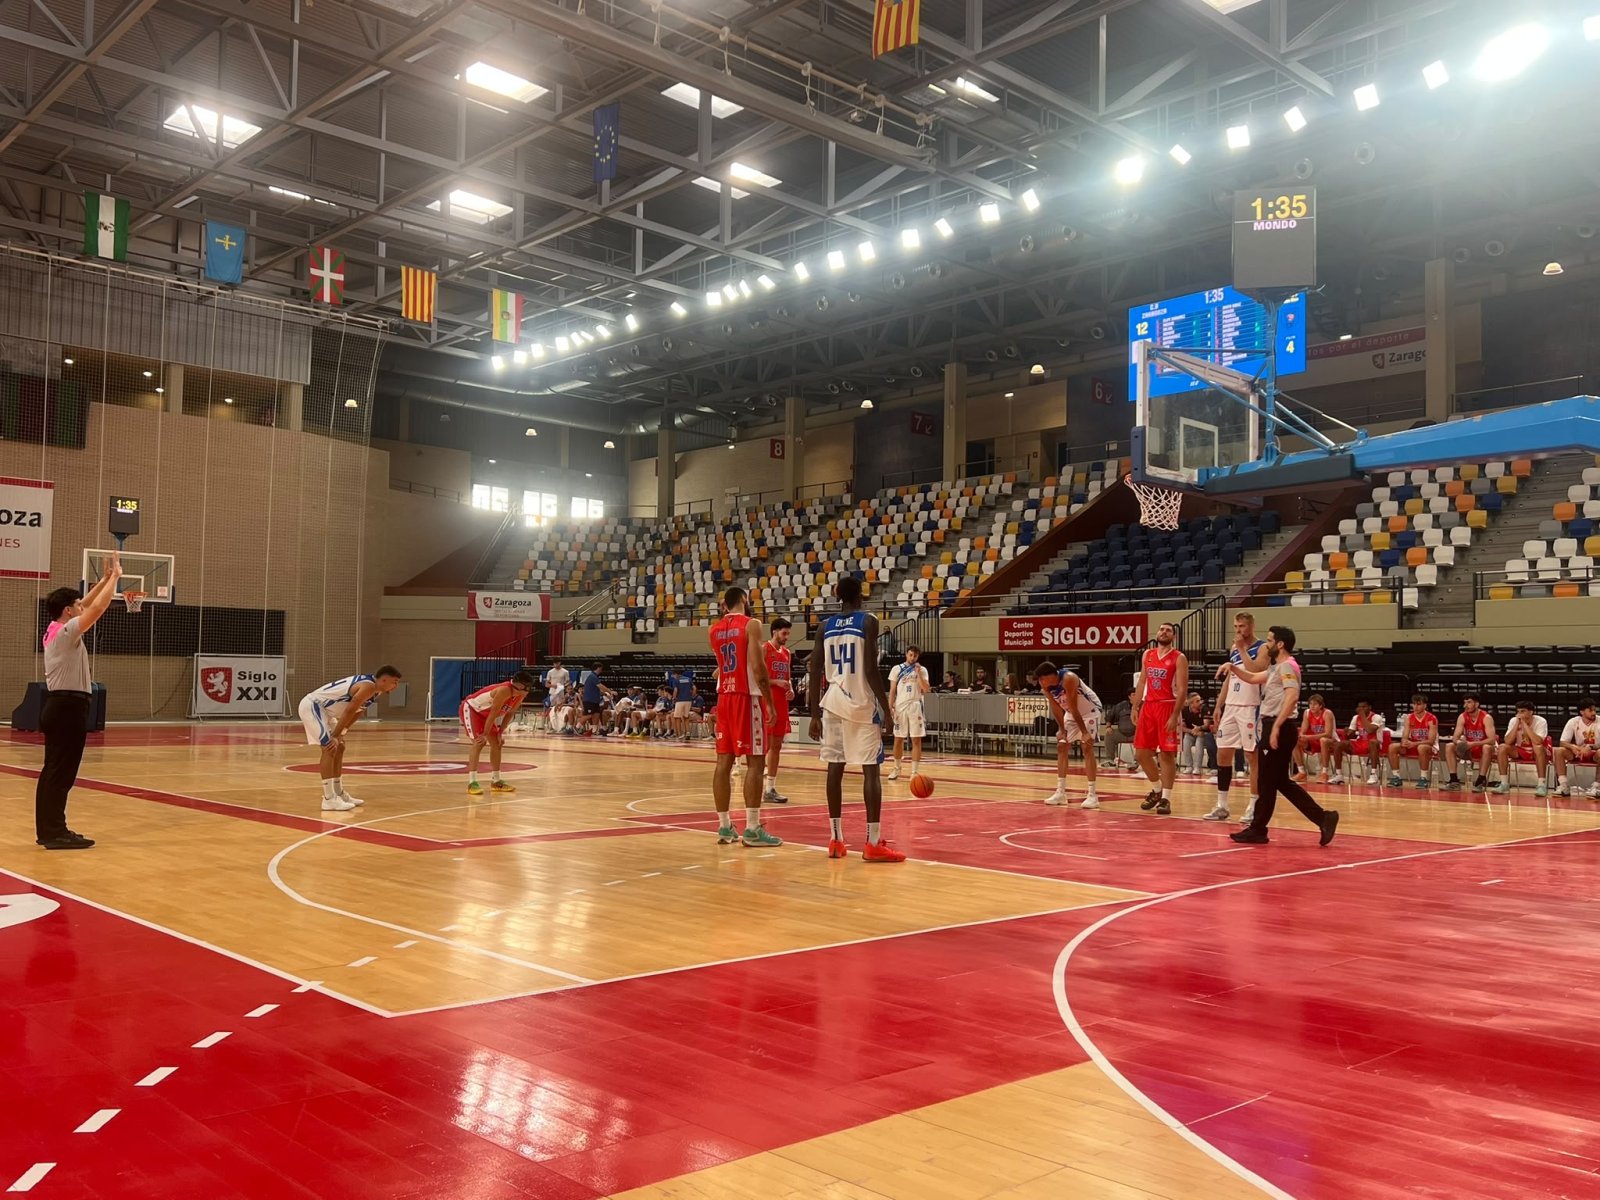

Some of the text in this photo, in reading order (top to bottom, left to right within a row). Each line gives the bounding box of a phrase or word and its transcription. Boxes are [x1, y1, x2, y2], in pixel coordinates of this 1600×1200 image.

[1251, 194, 1307, 220] 1:35
[1253, 219, 1297, 231] MONDO
[1204, 288, 1224, 304] 1:35
[1136, 322, 1149, 336] 12
[1285, 340, 1295, 354] 4
[1095, 382, 1103, 400] 6
[914, 415, 922, 431] 7
[774, 442, 783, 457] 8
[116, 499, 138, 511] 1:35
[494, 597, 532, 609] Zaragoza
[1012, 621, 1034, 629] Centro
[1004, 630, 1034, 639] Deportivo
[1041, 625, 1142, 645] SIGLO XXI
[1004, 638, 1034, 647] Municipal
[829, 642, 856, 675] 44
[237, 670, 278, 683] Siglo
[235, 686, 278, 701] XXI
[1017, 702, 1049, 713] Zaragoza
